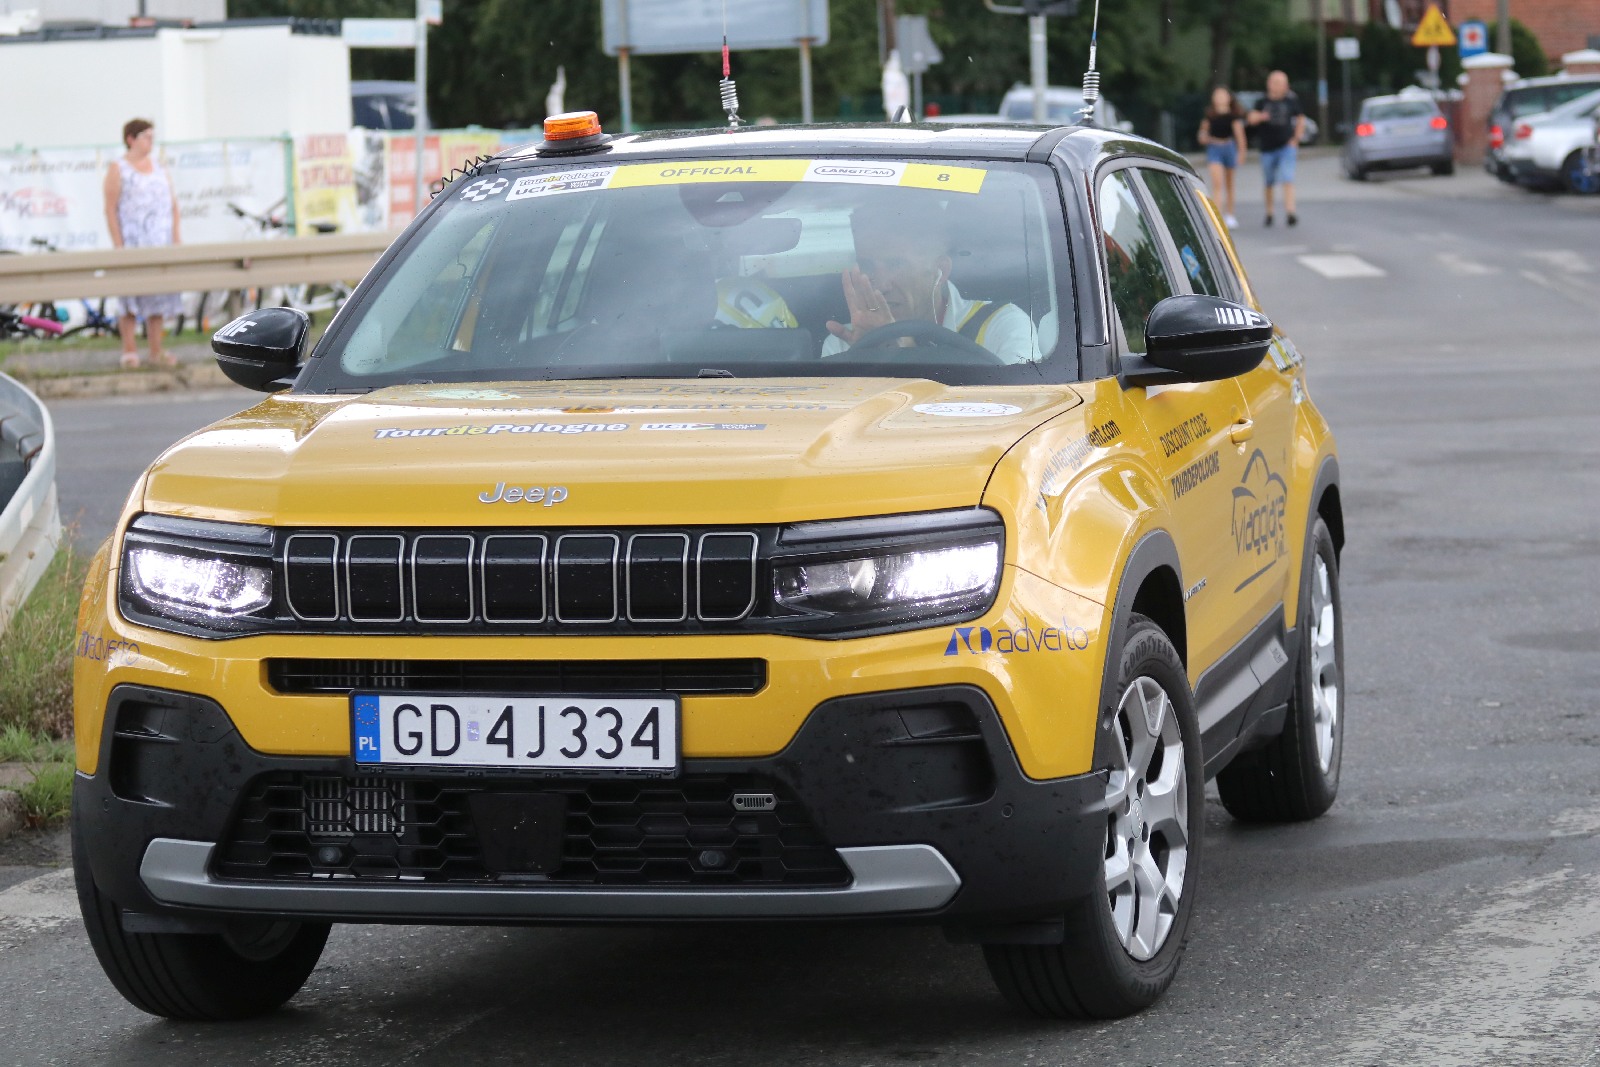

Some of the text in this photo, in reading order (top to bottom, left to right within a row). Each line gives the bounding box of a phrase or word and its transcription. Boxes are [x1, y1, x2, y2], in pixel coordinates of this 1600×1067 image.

[660, 166, 758, 178] OFFICIAL
[937, 173, 950, 182] 8
[515, 185, 546, 196] UCI
[374, 423, 628, 440] TourdePologne
[1159, 421, 1193, 458] DISCOUNT
[1171, 450, 1219, 500] TOURDEPOLOGNE
[478, 481, 568, 507] Jeep
[997, 616, 1089, 653] adverto
[393, 704, 660, 760] GD 4J334
[359, 737, 377, 751] PL
